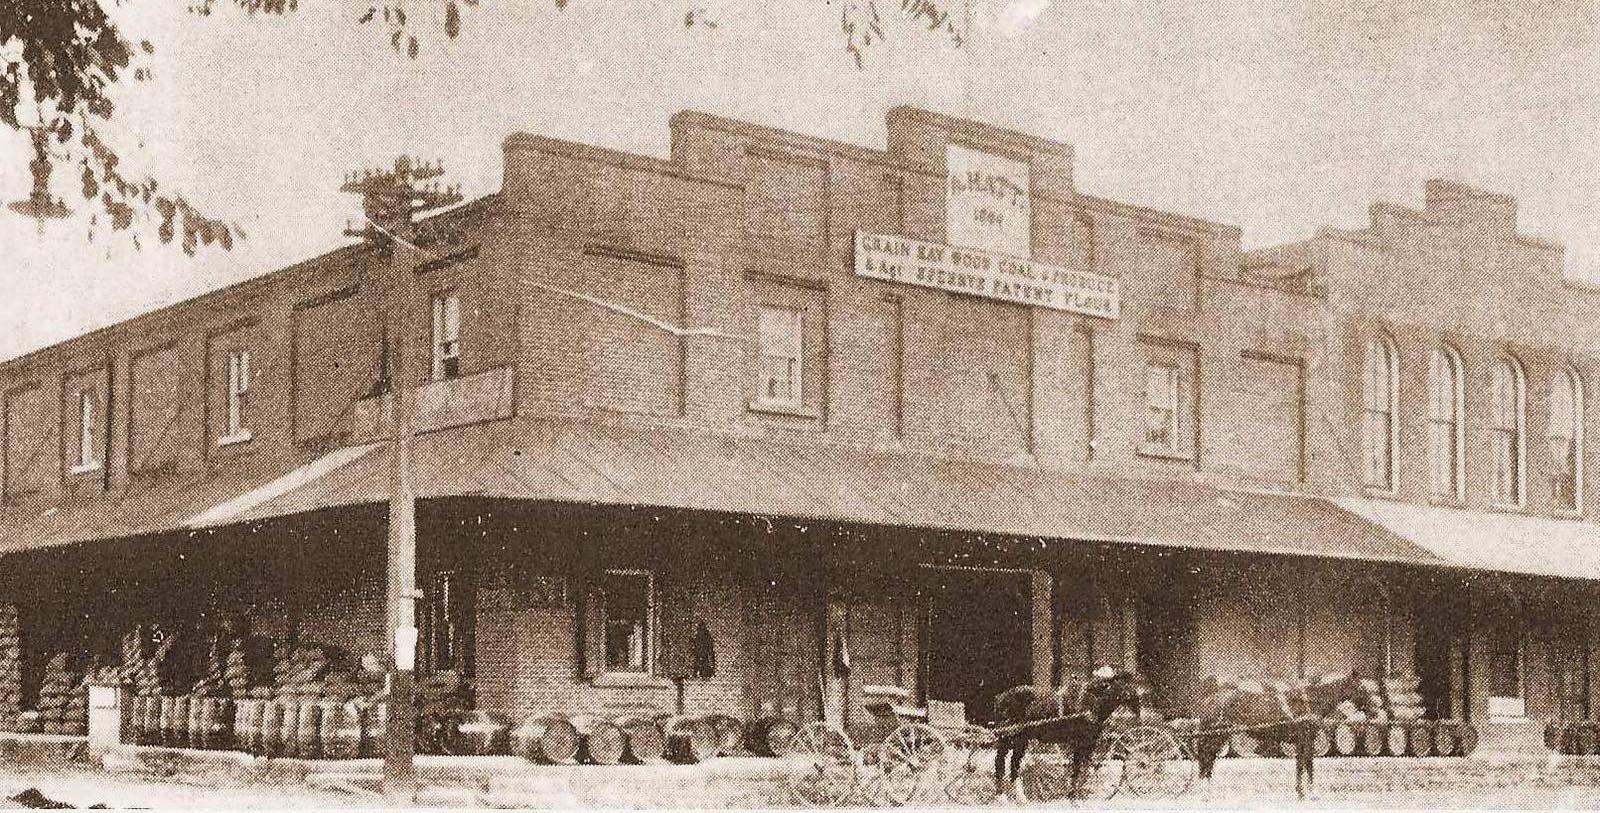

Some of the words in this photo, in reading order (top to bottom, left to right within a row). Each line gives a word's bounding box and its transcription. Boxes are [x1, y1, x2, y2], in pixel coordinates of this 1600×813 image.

[863, 236, 910, 257] GRAIN
[917, 245, 945, 263] HAY
[950, 251, 990, 271] WOOD
[999, 260, 1036, 281] COAL
[1053, 270, 1114, 295] PRODUCE
[993, 278, 1053, 303] PATENT
[1065, 291, 1112, 313] FLOUR
